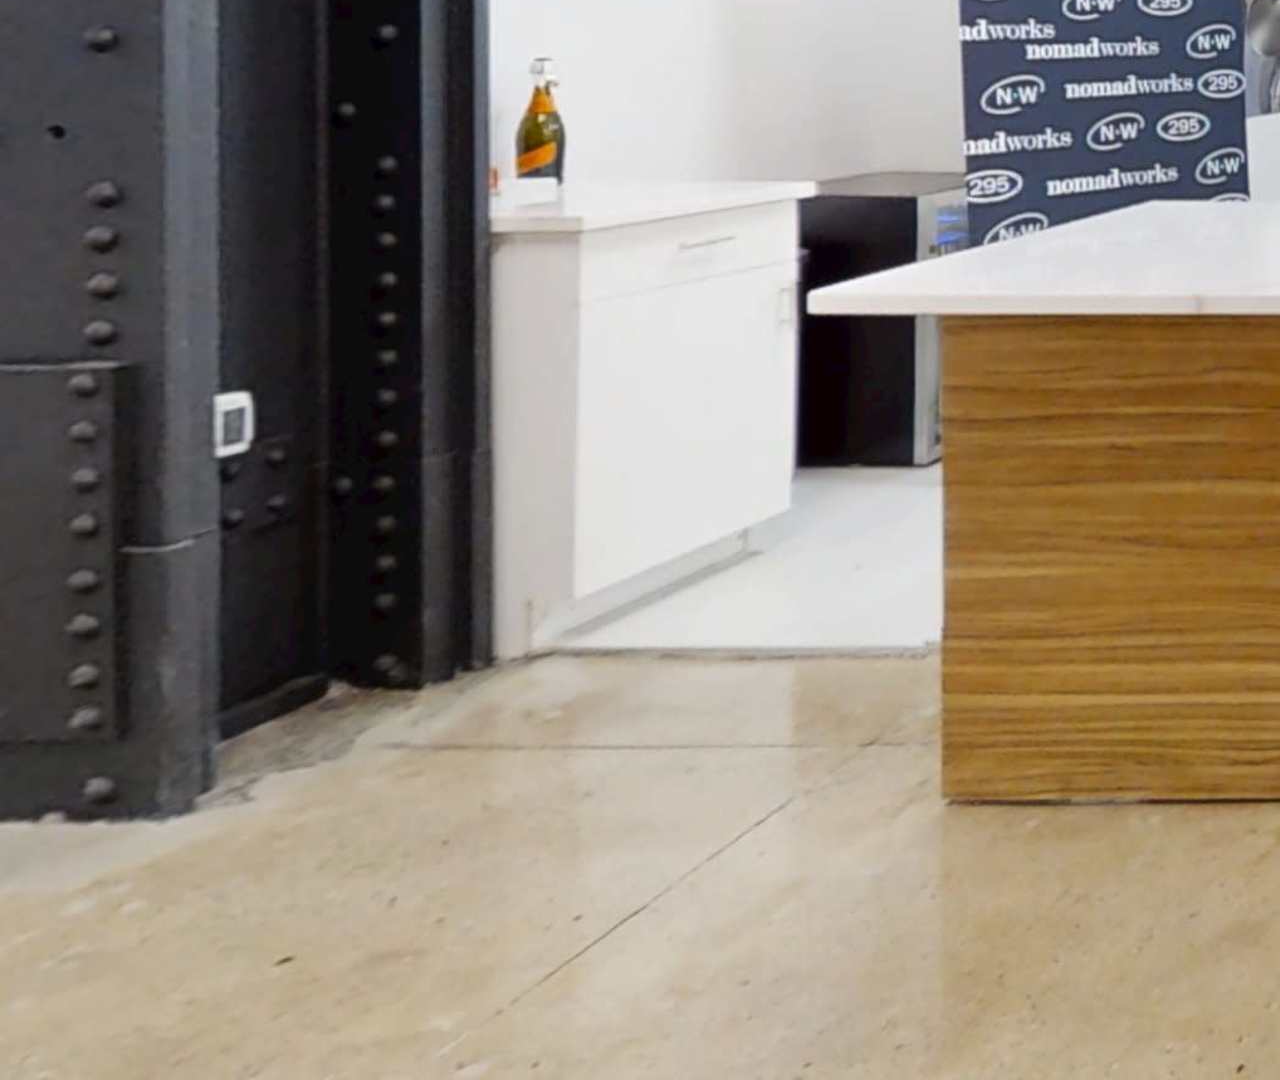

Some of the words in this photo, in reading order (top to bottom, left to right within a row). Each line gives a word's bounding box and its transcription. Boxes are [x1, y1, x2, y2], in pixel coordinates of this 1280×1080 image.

[1025, 36, 1161, 60] nomadworks
[1063, 74, 1194, 99] nomadworks
[1207, 76, 1238, 91] 295
[1167, 118, 1200, 135] 295
[969, 176, 1010, 196] 295
[1046, 164, 1179, 196] nomadworks
